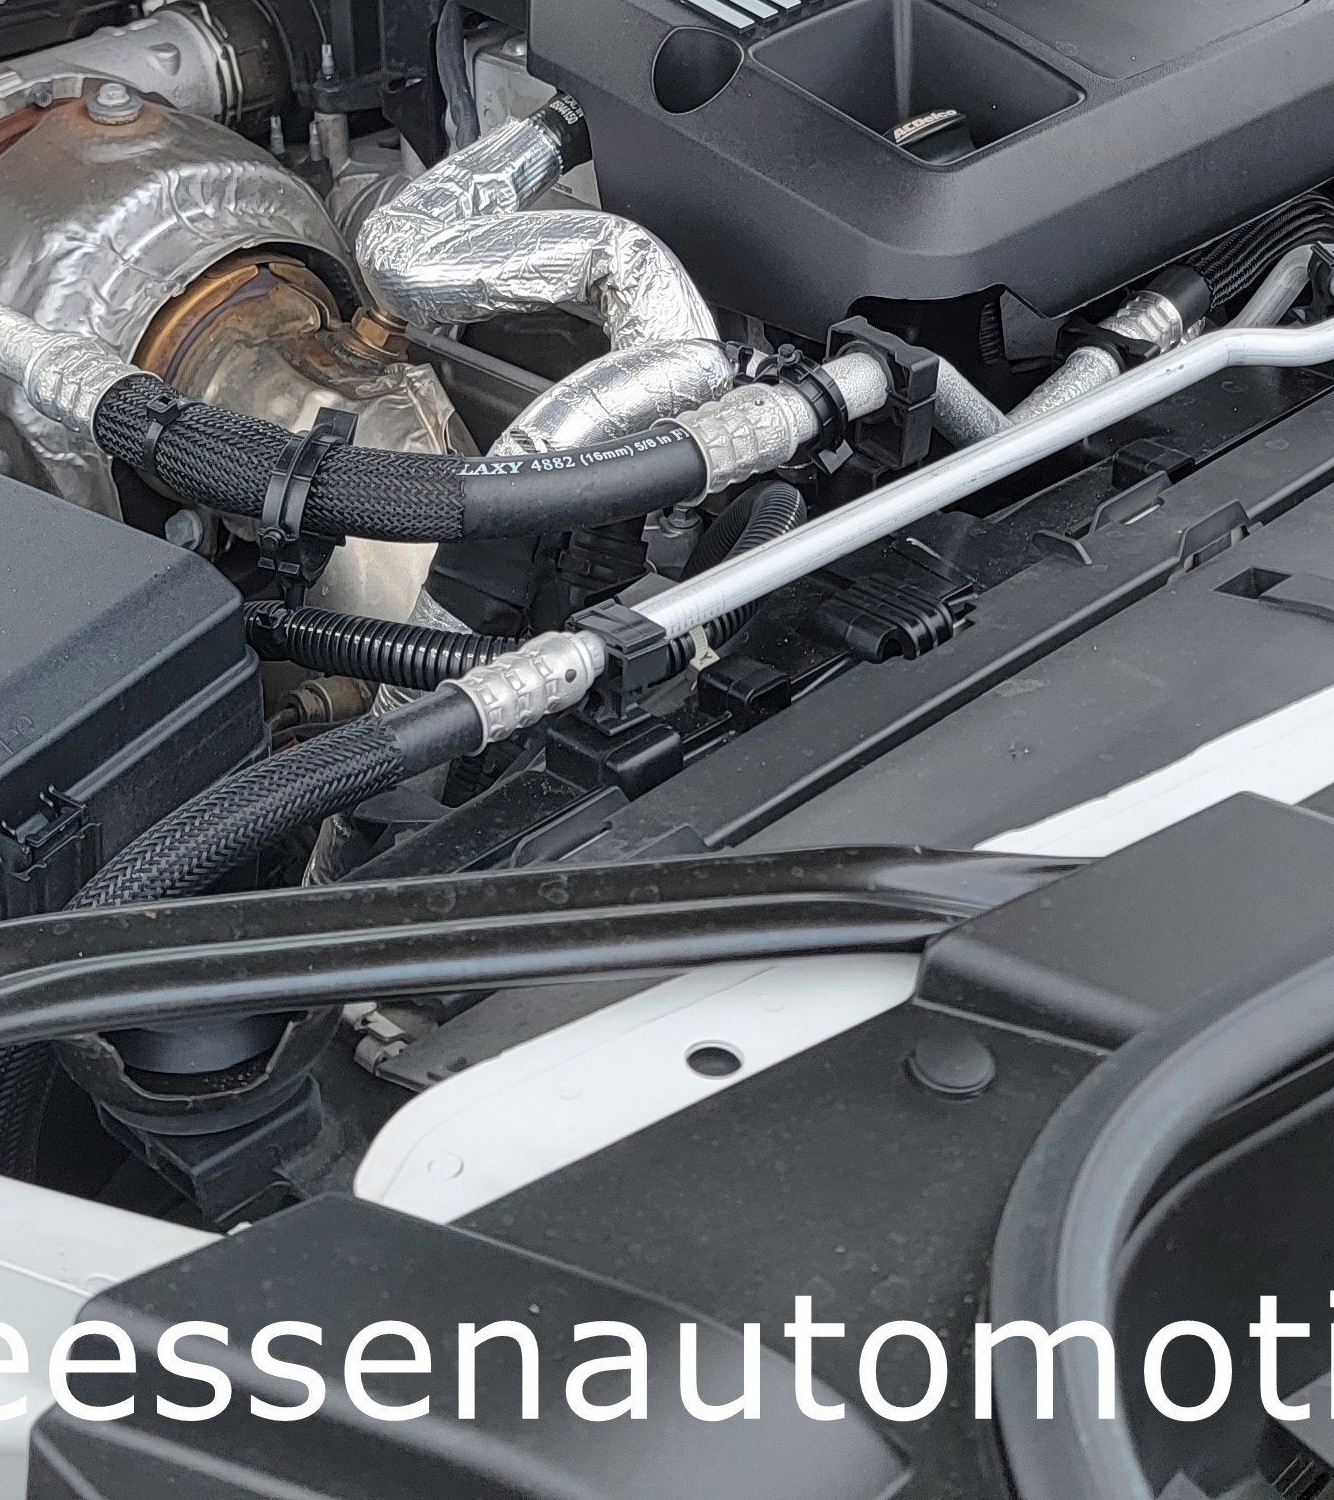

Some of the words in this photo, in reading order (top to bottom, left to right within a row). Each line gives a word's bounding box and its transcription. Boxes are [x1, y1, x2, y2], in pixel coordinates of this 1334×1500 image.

[455, 460, 524, 476] LAXY
[530, 455, 576, 472] 4882
[579, 446, 635, 468] (16mm)
[634, 437, 658, 452] 5/8
